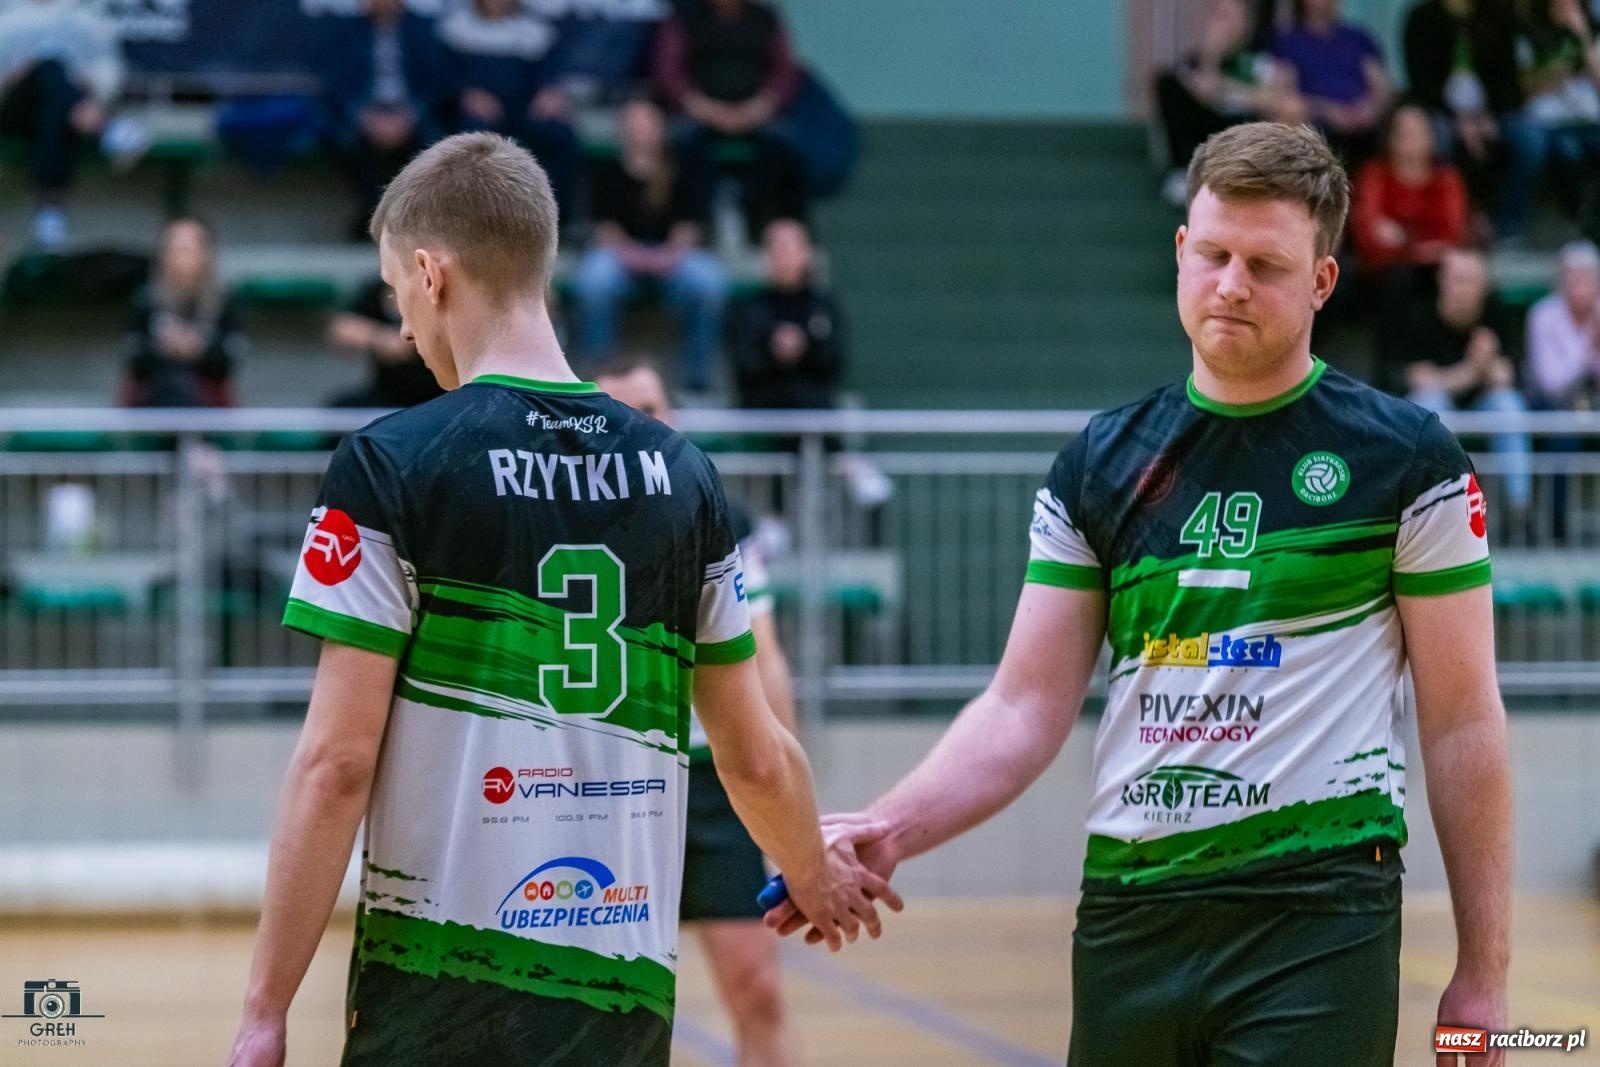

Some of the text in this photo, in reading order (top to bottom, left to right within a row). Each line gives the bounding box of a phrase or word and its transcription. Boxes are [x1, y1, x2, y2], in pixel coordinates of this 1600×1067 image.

[525, 410, 609, 434] #TeamKSR
[487, 448, 672, 501] RZYTKI M
[1178, 491, 1263, 558] 49
[303, 527, 362, 567] RV
[537, 544, 627, 718] 3
[1139, 694, 1264, 722] PIVEXIN
[518, 768, 573, 778] RADIO
[518, 779, 666, 799] VANESSA
[512, 815, 530, 824] FM
[588, 813, 608, 822] FM
[1143, 810, 1193, 824] KIETRZ
[602, 885, 649, 904] MULTI
[501, 903, 650, 929] UBEZPIECZENIA
